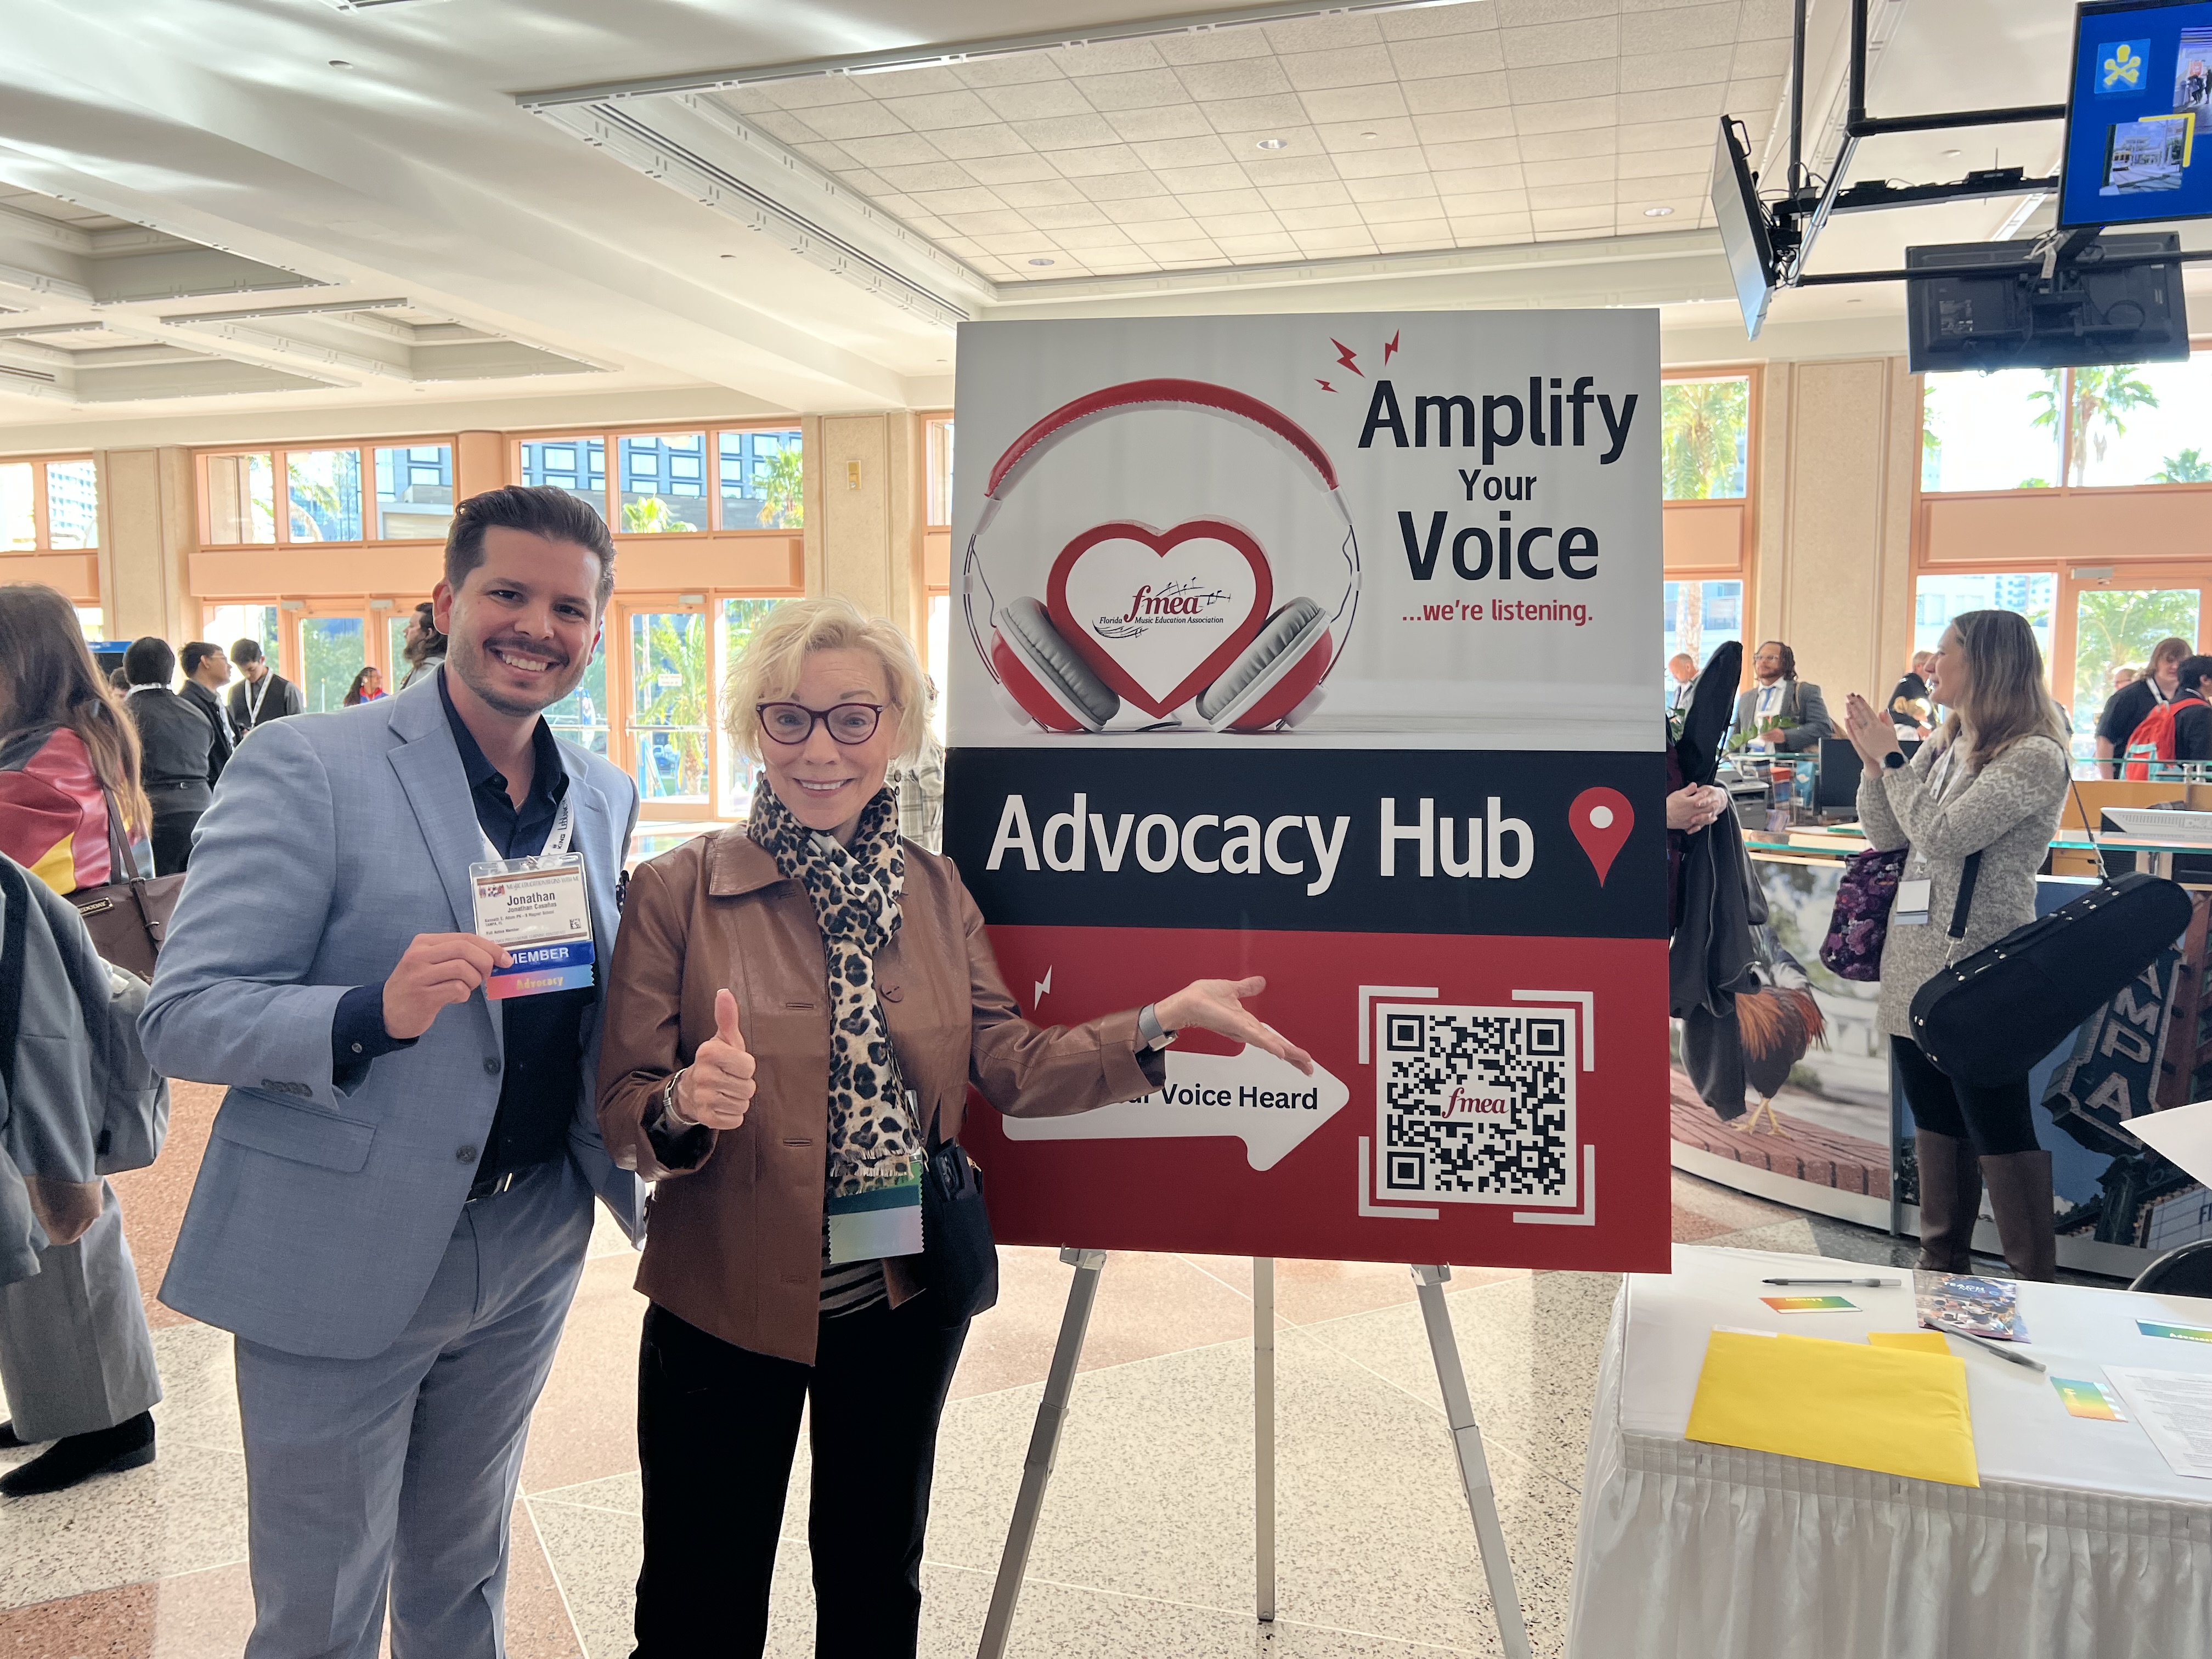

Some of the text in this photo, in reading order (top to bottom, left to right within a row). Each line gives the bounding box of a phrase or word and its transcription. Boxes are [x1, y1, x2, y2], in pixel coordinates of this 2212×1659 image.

[1358, 376, 1638, 465] Amplify
[1458, 469, 1537, 500] Your
[1397, 511, 1599, 580] Voice
[1124, 585, 1203, 623] fmea
[1403, 600, 1593, 626] ...we're listening.
[1099, 616, 1122, 624] Florida
[556, 833, 566, 849] KING
[986, 793, 1534, 896] Advocacy Hub
[507, 892, 555, 906] Jonathan
[516, 977, 564, 991] Advocacy
[1161, 1084, 1232, 1106] Voice
[1239, 1086, 1318, 1110] Heard
[1441, 1087, 1509, 1119] fmea
